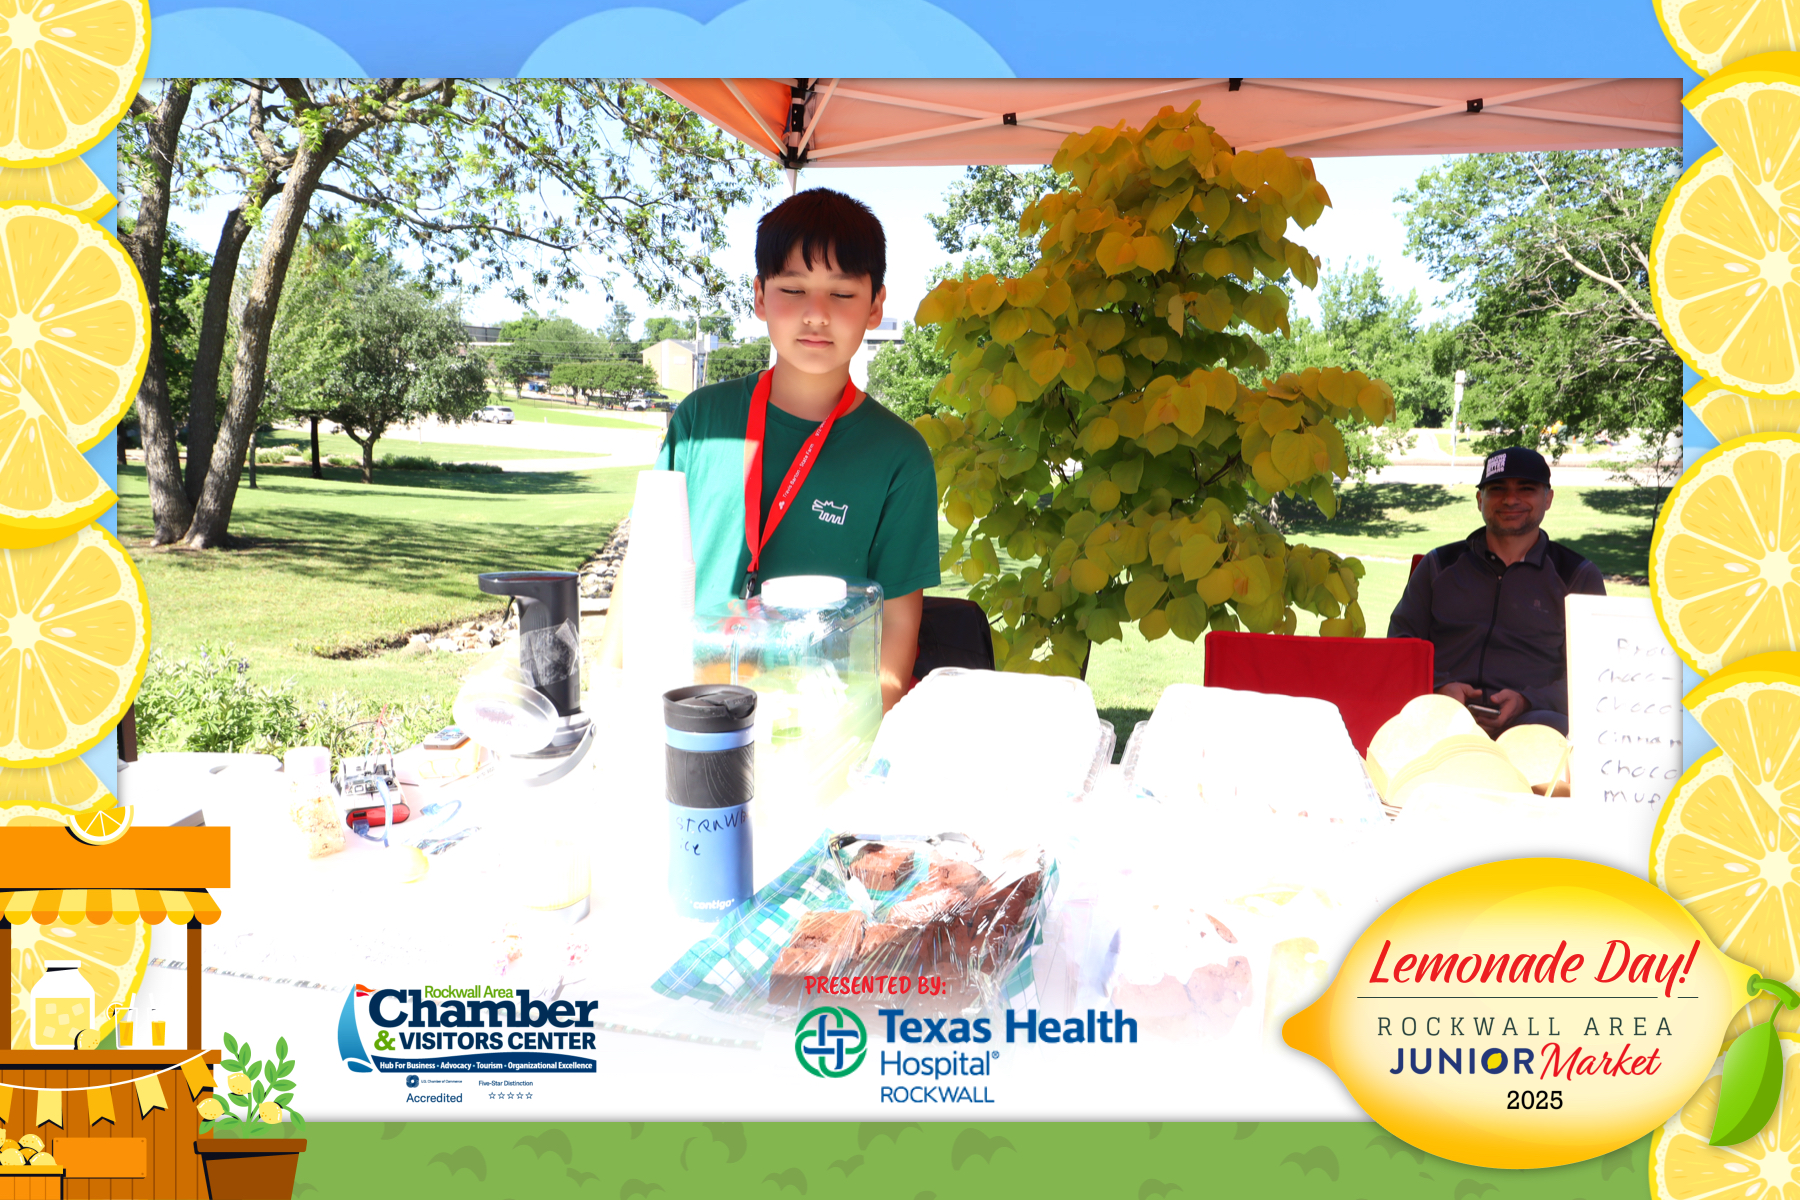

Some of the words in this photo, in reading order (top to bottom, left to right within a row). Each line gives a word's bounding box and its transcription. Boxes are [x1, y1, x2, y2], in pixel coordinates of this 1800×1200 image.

[783, 485, 793, 498] Travis
[799, 454, 809, 468] State
[806, 443, 815, 456] Farm
[692, 900, 732, 911] contigo
